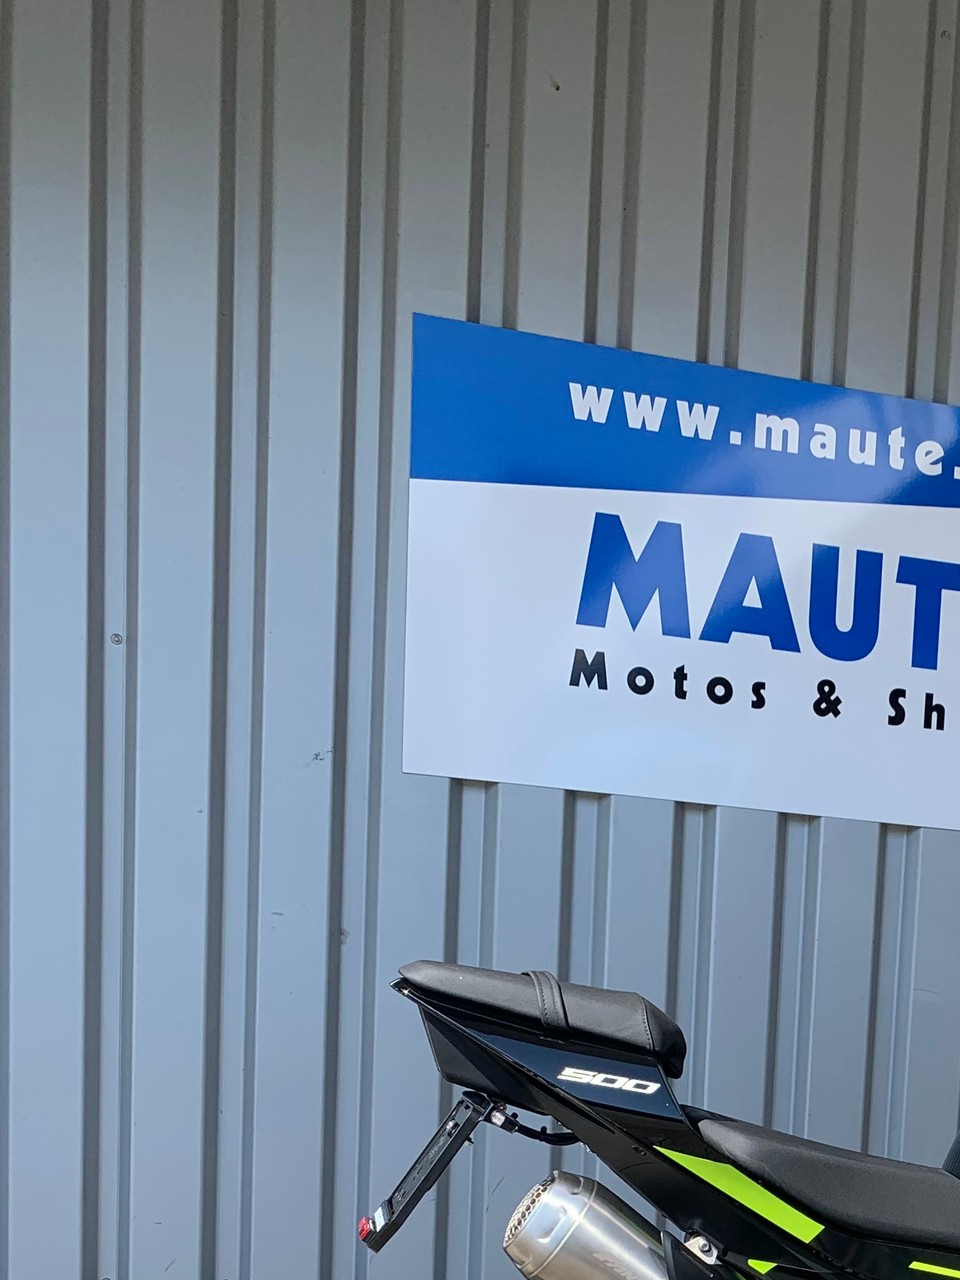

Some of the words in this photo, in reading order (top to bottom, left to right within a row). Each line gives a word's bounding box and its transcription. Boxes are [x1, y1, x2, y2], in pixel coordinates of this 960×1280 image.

[569, 648, 766, 710] Motos
[812, 679, 843, 719] &
[556, 1066, 661, 1095] 500
